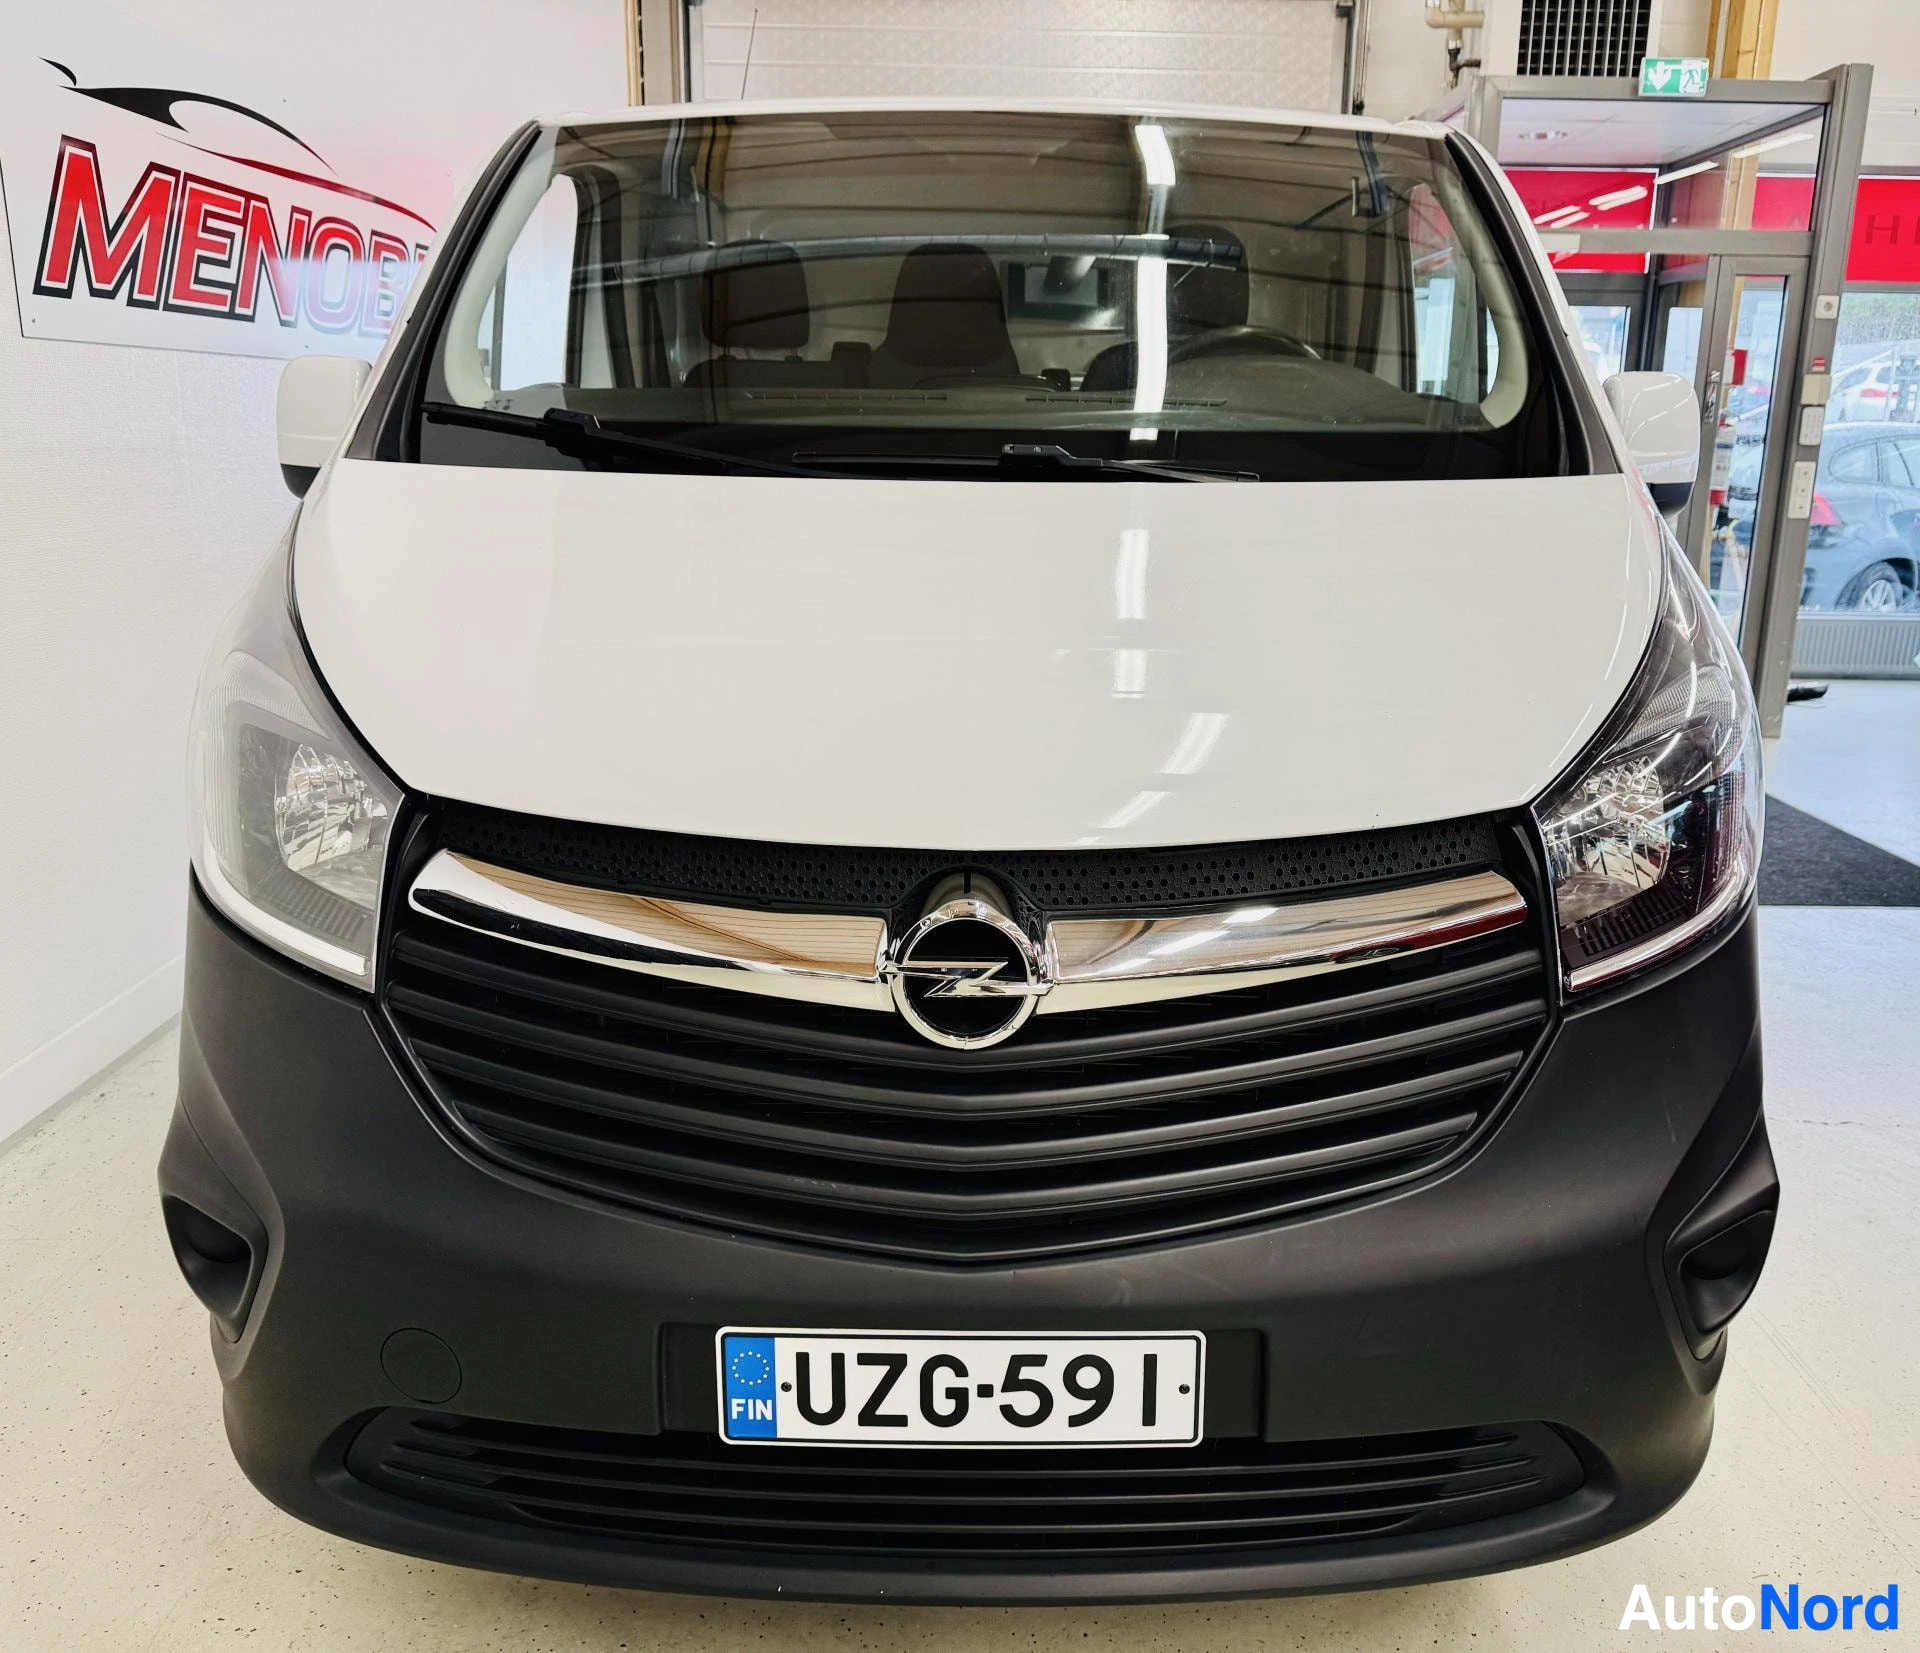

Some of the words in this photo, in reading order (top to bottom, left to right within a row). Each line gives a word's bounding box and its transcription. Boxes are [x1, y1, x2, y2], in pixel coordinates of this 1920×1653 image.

[32, 133, 430, 339] MENOB
[732, 1398, 774, 1421] FIN
[795, 1351, 1158, 1428] UZG-591
